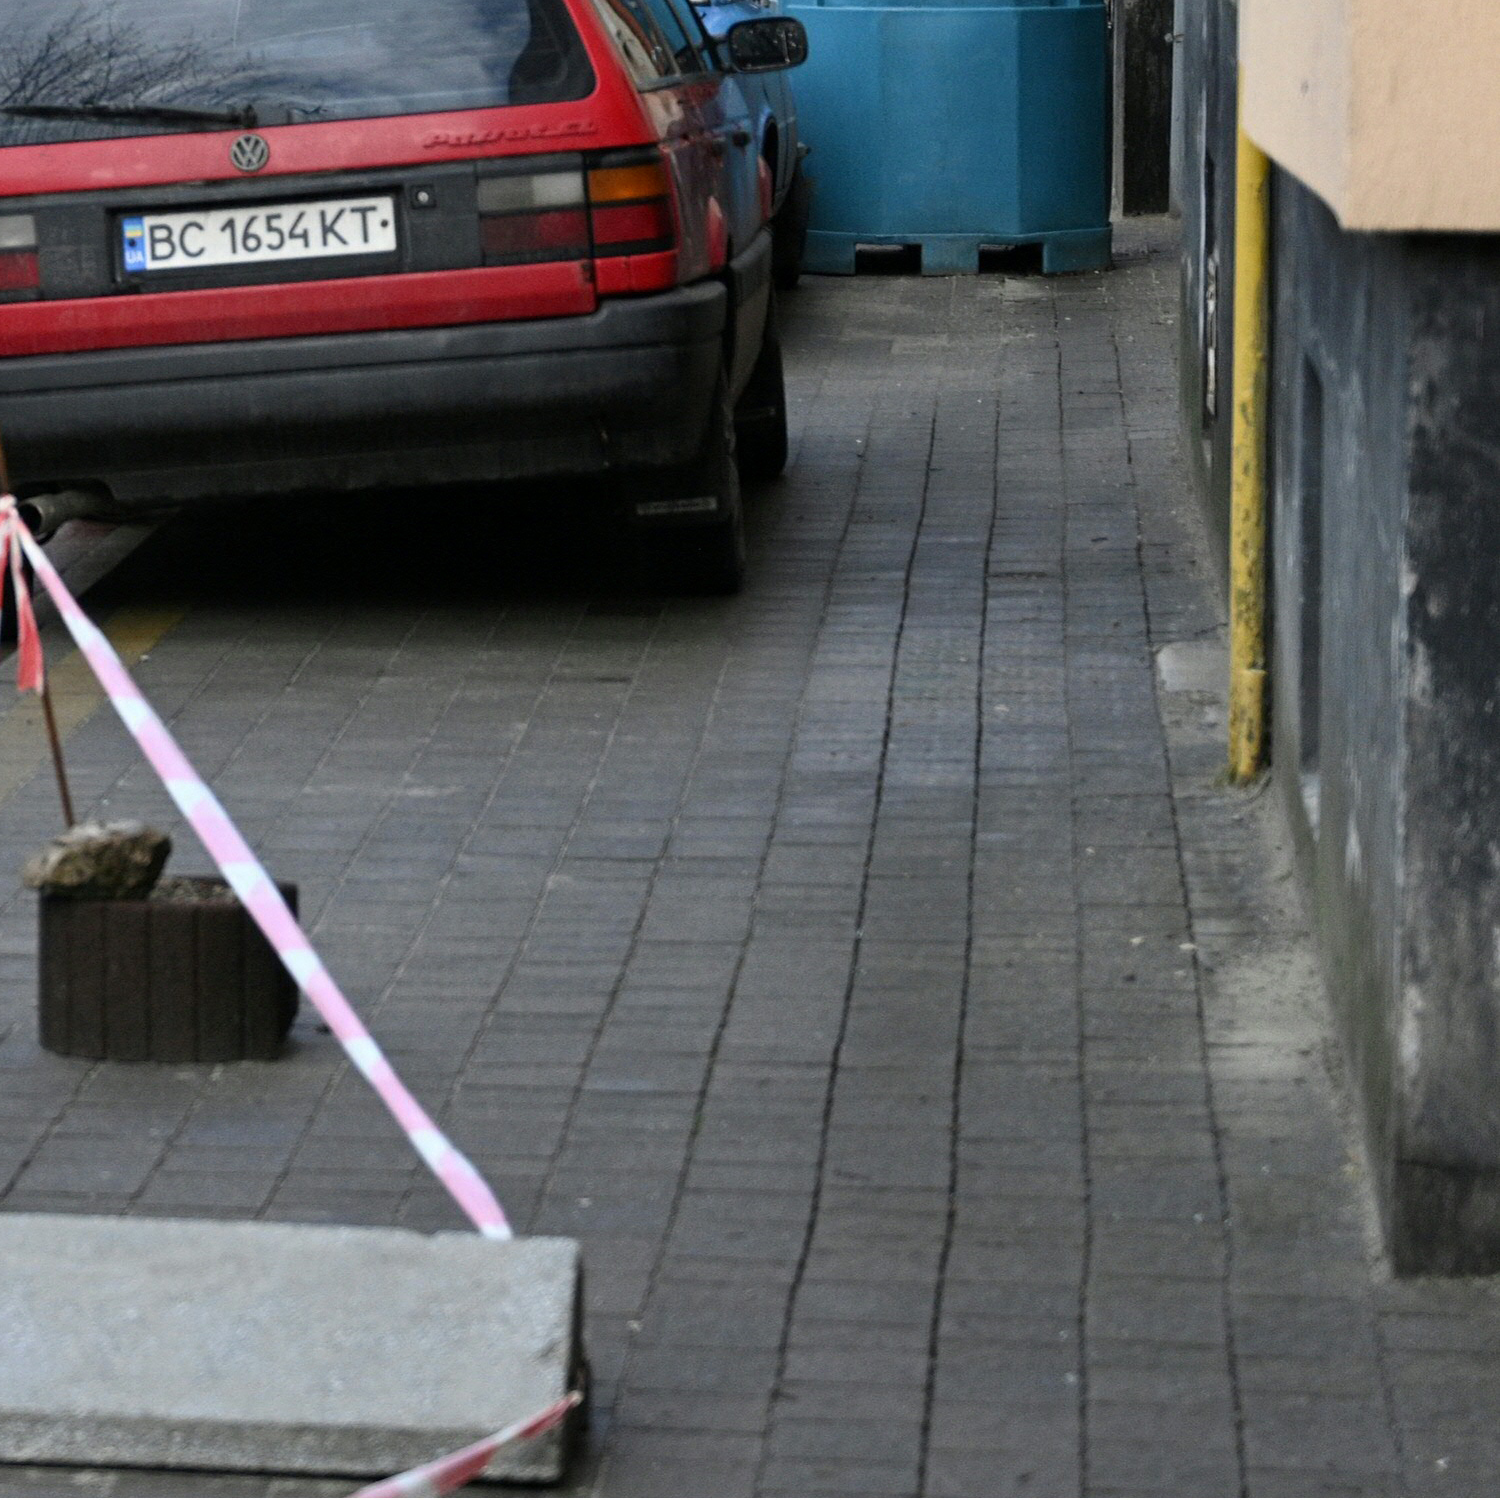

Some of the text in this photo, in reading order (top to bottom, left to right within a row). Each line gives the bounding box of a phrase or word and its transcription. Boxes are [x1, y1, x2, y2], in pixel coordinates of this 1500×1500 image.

[149, 205, 378, 261] BC 1654 KT
[125, 250, 144, 264] UA
